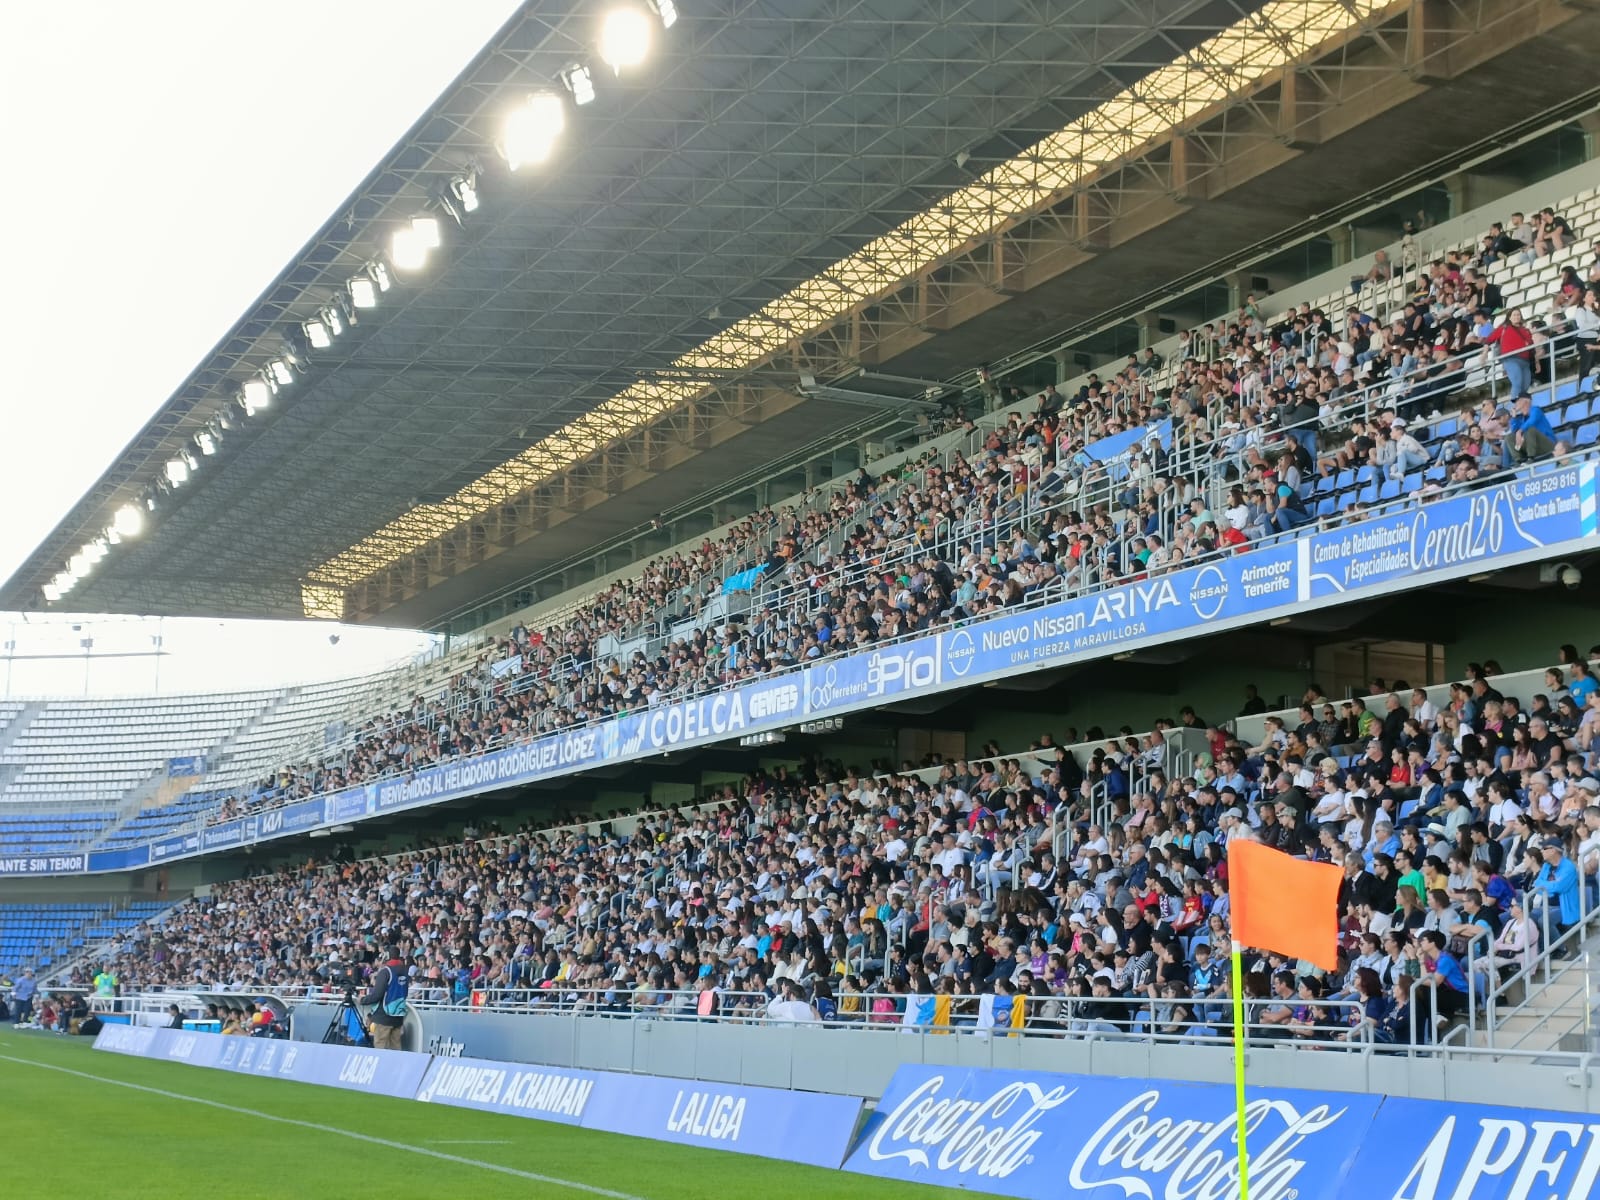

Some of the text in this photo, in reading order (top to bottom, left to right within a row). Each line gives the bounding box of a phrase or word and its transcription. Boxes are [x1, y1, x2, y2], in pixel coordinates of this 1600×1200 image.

[1525, 471, 1576, 497] 699 529 816
[1410, 490, 1504, 571] Cerad26
[1518, 506, 1534, 523] Santa
[1534, 502, 1548, 519] Cruz
[1314, 521, 1409, 563] Centro de Rehabilitación
[1241, 559, 1292, 583] Arimotor
[1244, 575, 1290, 598] Tenerife
[1344, 549, 1409, 585] y Especialidades
[1190, 583, 1228, 602] NISSAN
[982, 579, 1181, 652] Nuevo Nissan ARIYA
[948, 645, 975, 661] NISSAN
[1011, 622, 1146, 664] UNA FUERZA MARAVILLOSA
[650, 690, 745, 747] COELCA
[380, 733, 596, 807] BIENVENIDOS AL HELIODORO RODRÍGUEZ LÓPEZ
[29, 858, 47, 872] SIN
[49, 857, 82, 871] TEMOR
[339, 1053, 379, 1086] LALIGA
[437, 1062, 594, 1118] LIMPIEZA ACHAMAN
[666, 1089, 746, 1142] LALIGA
[868, 1075, 1079, 1179] Coca-Cola
